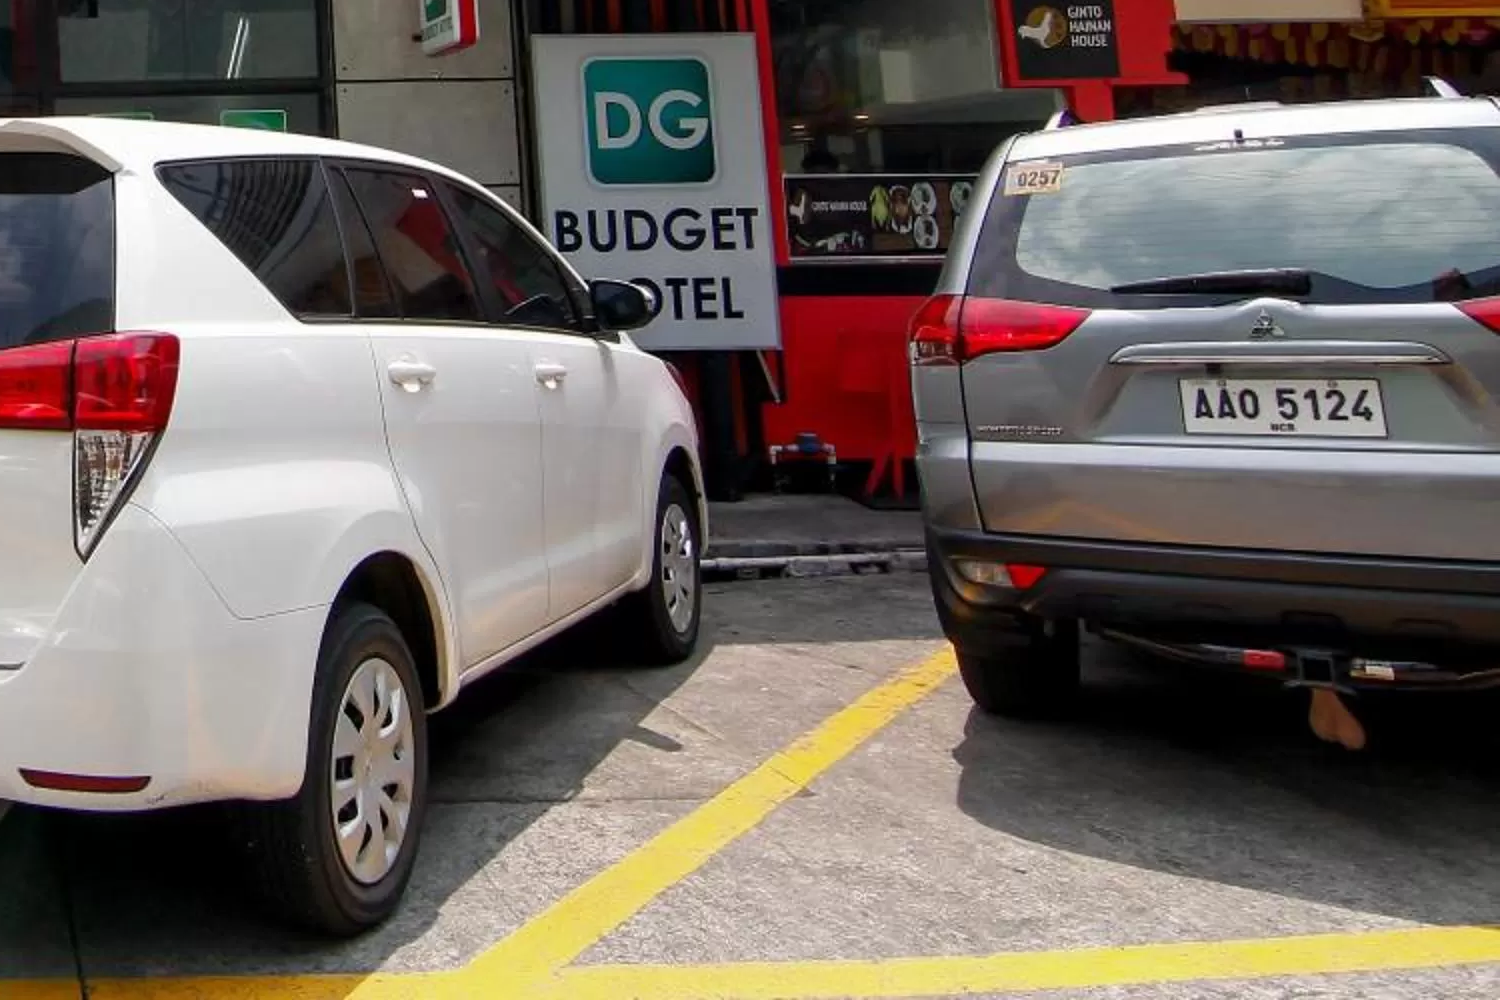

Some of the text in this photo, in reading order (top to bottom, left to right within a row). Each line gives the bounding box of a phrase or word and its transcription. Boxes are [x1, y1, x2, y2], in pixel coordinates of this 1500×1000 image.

[1067, 5, 1102, 18] GINTO
[1069, 19, 1112, 33] HAINAN
[1071, 34, 1108, 47] HOUSE
[594, 89, 709, 150] DG
[1018, 170, 1060, 187] 0257
[555, 207, 759, 252] BUDGET
[1275, 388, 1373, 421] 5124
